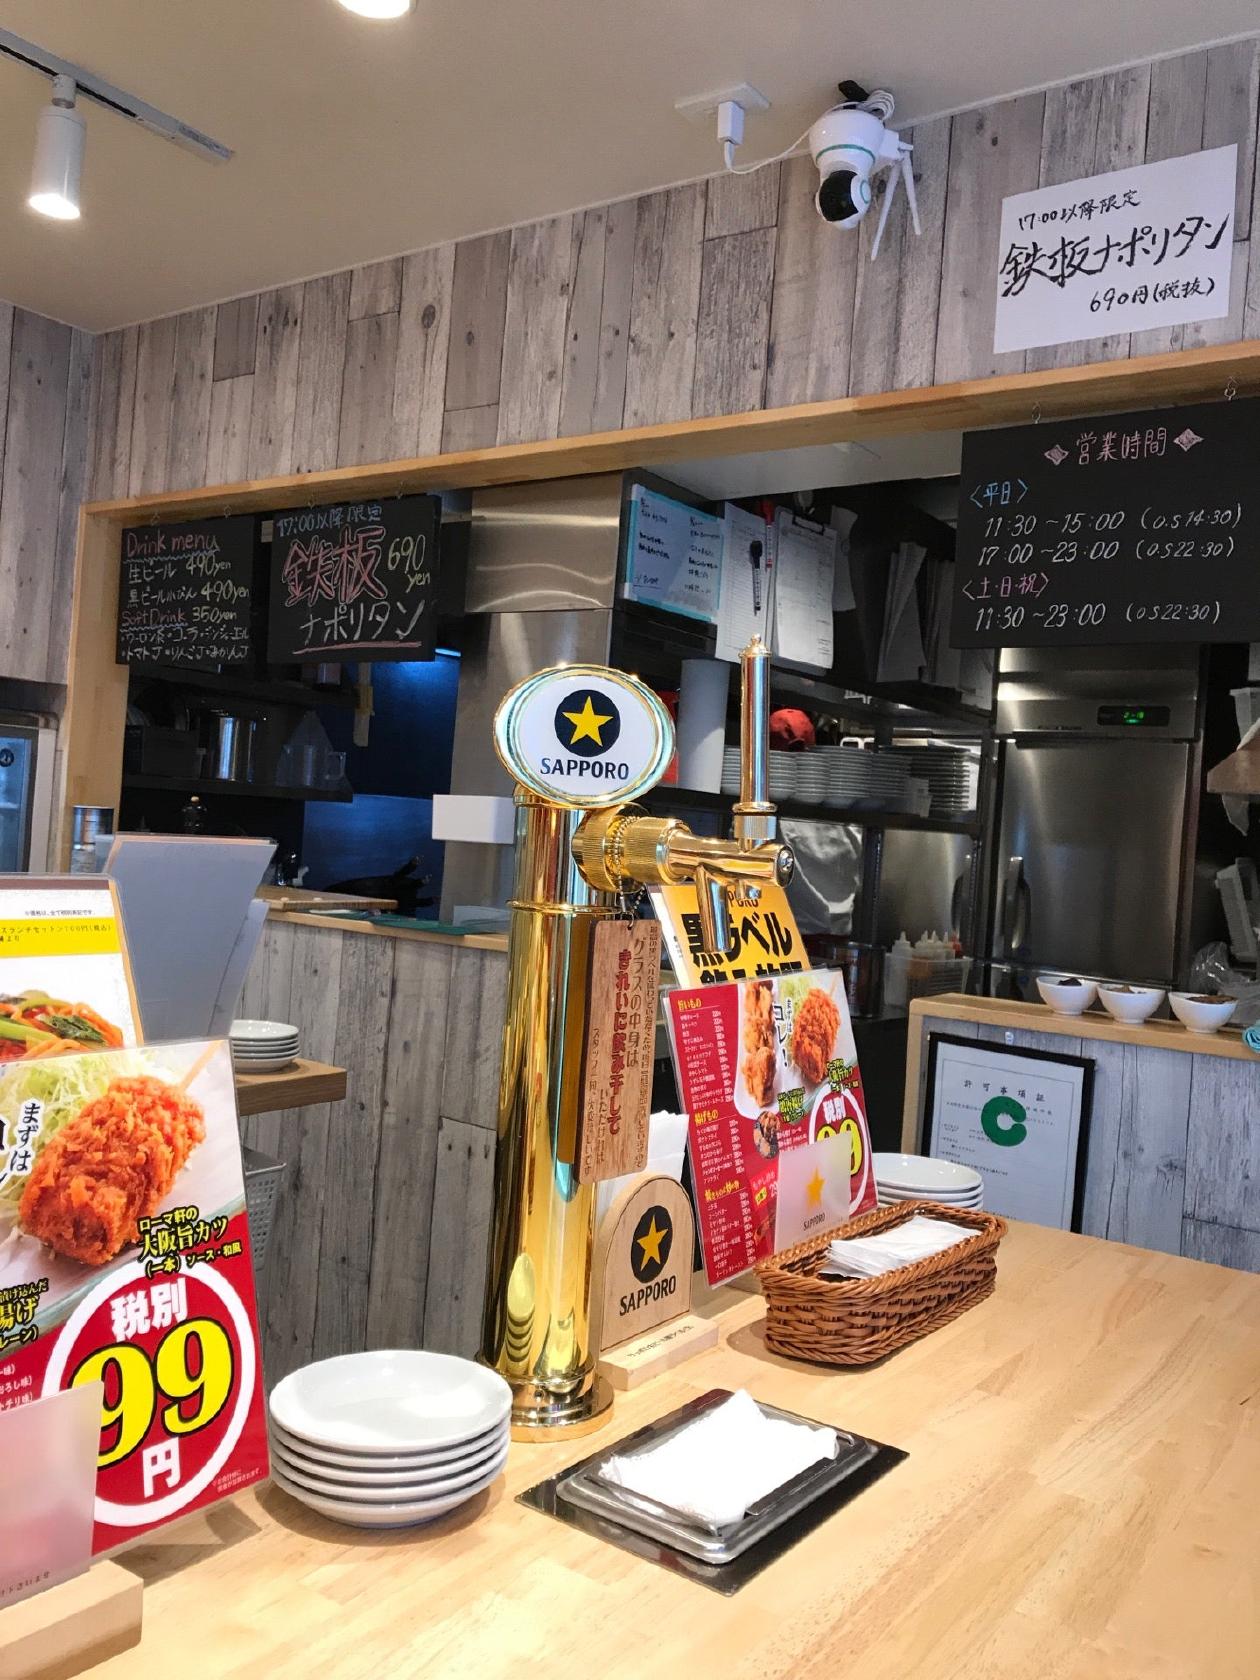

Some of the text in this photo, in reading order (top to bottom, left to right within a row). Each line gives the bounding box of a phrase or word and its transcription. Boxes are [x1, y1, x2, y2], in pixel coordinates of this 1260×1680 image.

[1018, 189, 1141, 230] 17:00以降限定
[999, 213, 1230, 297] 鉄板ナポリタン
[1089, 277, 1215, 312] 690円(税抜)
[1076, 427, 1168, 465] 営業時間
[127, 529, 220, 557] Drink menu
[387, 534, 426, 574] 690
[128, 562, 177, 584] 生ビール
[282, 524, 388, 607] 鉄板
[405, 572, 430, 593] yen
[299, 600, 426, 646] ナポリタン
[540, 757, 630, 780] SAPPORO
[625, 936, 648, 1068] グラスの中身は
[607, 948, 632, 1136] きれいに飲み干して
[10, 1102, 41, 1172] まずは
[138, 1216, 228, 1261] 大阪旨カツ
[139, 1206, 198, 1232] ローマ軒の
[803, 1212, 826, 1232] SAPPORO
[110, 1277, 188, 1342] 税別
[618, 1275, 676, 1317] SAPPORO
[142, 1437, 181, 1498] 円
